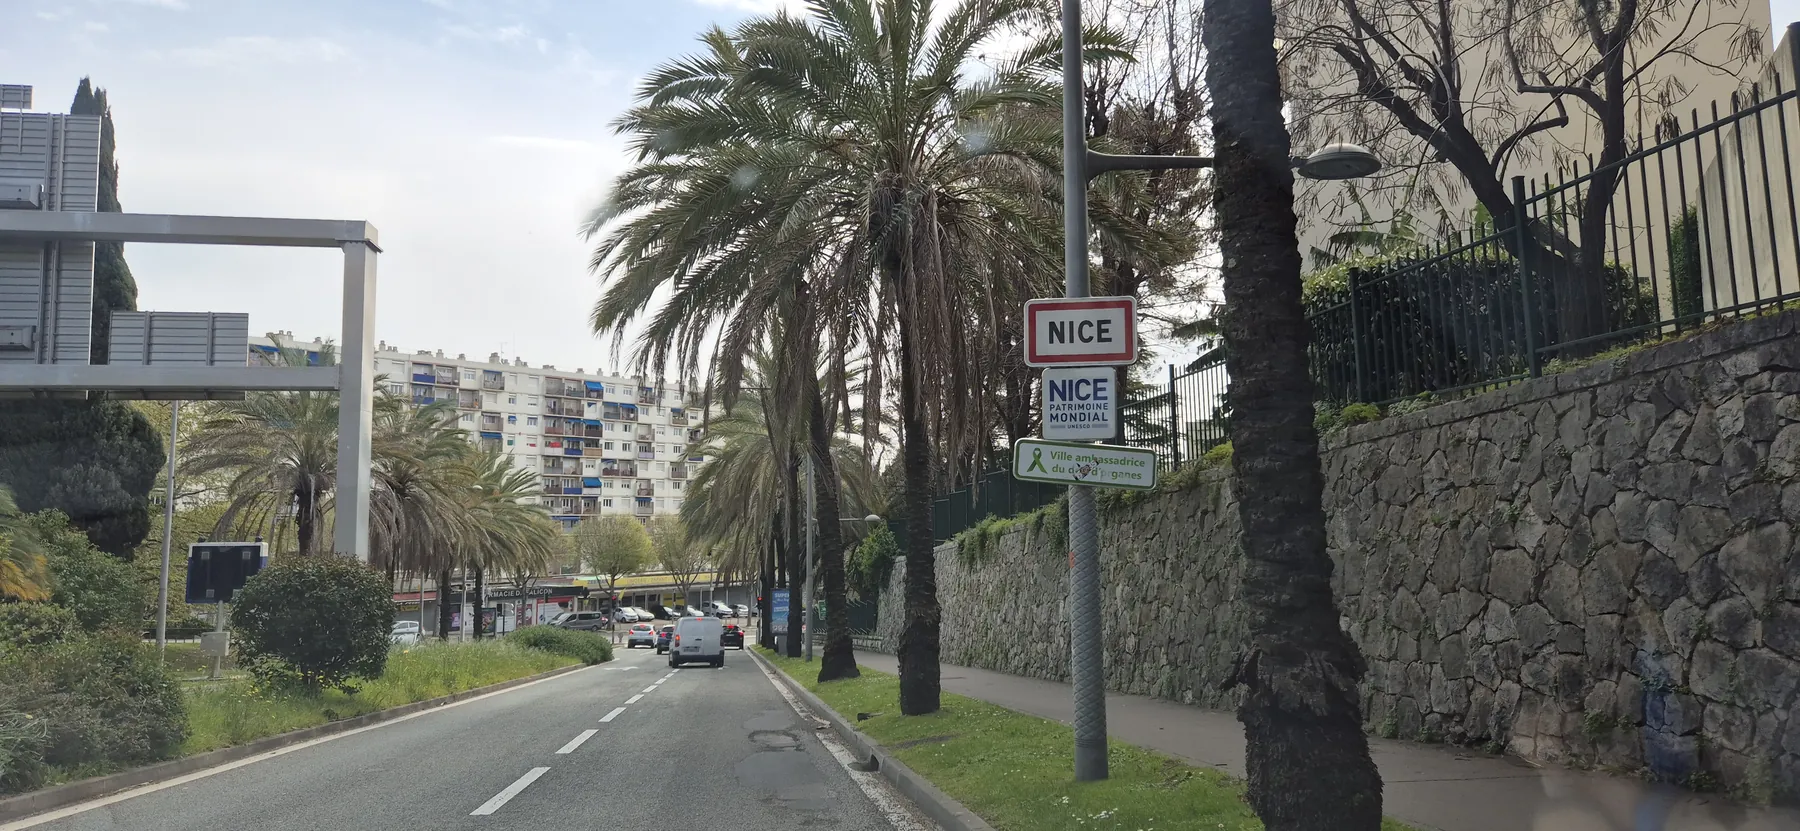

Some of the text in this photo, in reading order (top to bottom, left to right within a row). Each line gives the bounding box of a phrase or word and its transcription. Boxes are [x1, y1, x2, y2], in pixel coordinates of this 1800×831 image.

[1048, 320, 1112, 344] NICE
[1049, 378, 1108, 402] NICE
[1049, 402, 1109, 411] PATRIMOINE
[1049, 412, 1109, 422] MONDIAL
[1050, 451, 1145, 467] Ville ambassadrice
[1052, 463, 1065, 473] du
